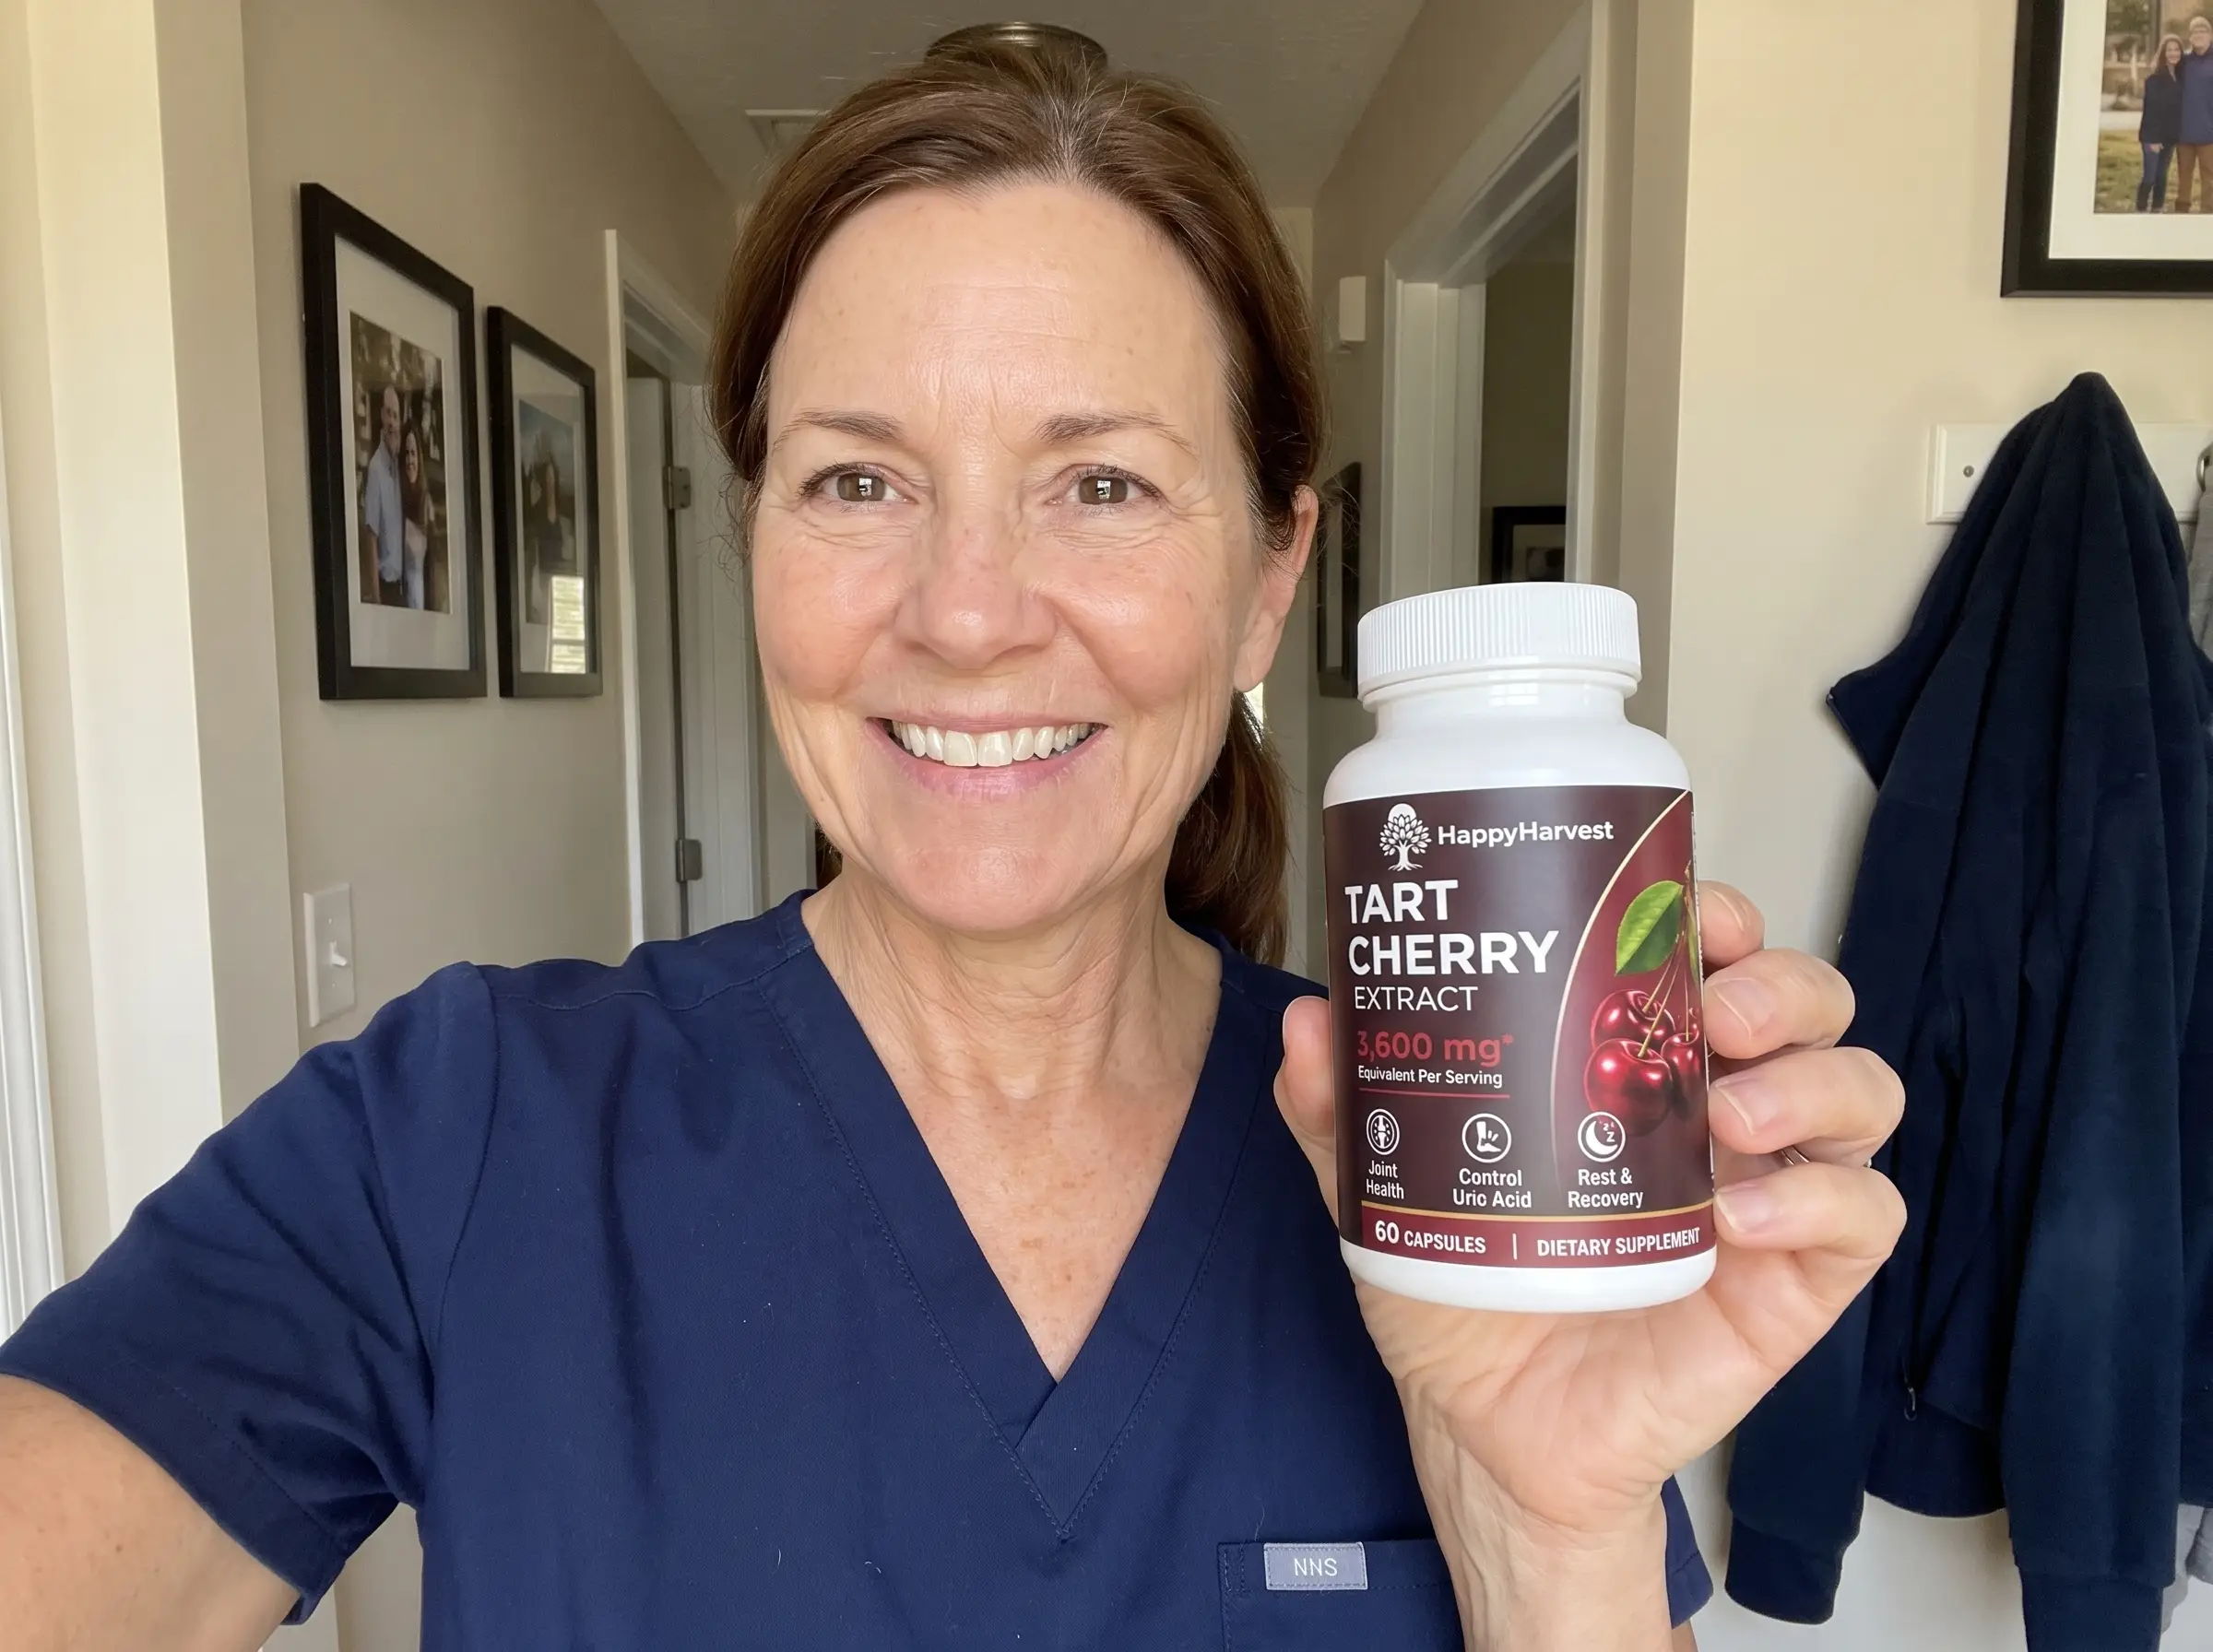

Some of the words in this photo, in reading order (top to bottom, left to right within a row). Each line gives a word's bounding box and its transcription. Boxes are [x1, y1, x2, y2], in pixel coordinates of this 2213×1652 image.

[1438, 820, 1614, 848] HappyHarvest
[1344, 879, 1459, 924] TART
[1348, 930, 1559, 975] CHERRY
[1354, 985, 1478, 1011] EXTRACT
[1357, 1030, 1433, 1062] 3,600
[1358, 1065, 1415, 1082] Equivalent
[1418, 1068, 1442, 1083] Per
[1445, 1069, 1503, 1089] Serving
[1368, 1160, 1398, 1178] Joint
[1459, 1167, 1522, 1186] Control
[1578, 1169, 1616, 1186] Rest
[1620, 1167, 1633, 1185] &
[1366, 1178, 1404, 1199] Health
[1452, 1188, 1487, 1207] Uric
[1492, 1190, 1533, 1209] Acid
[1568, 1191, 1643, 1209] Recovery
[1375, 1220, 1400, 1245] 60
[1403, 1229, 1486, 1254] CAPSULES
[1537, 1237, 1612, 1257] DIETARY
[1615, 1227, 1700, 1255] SUPPLEMENT
[1294, 1558, 1338, 1576] NNS
